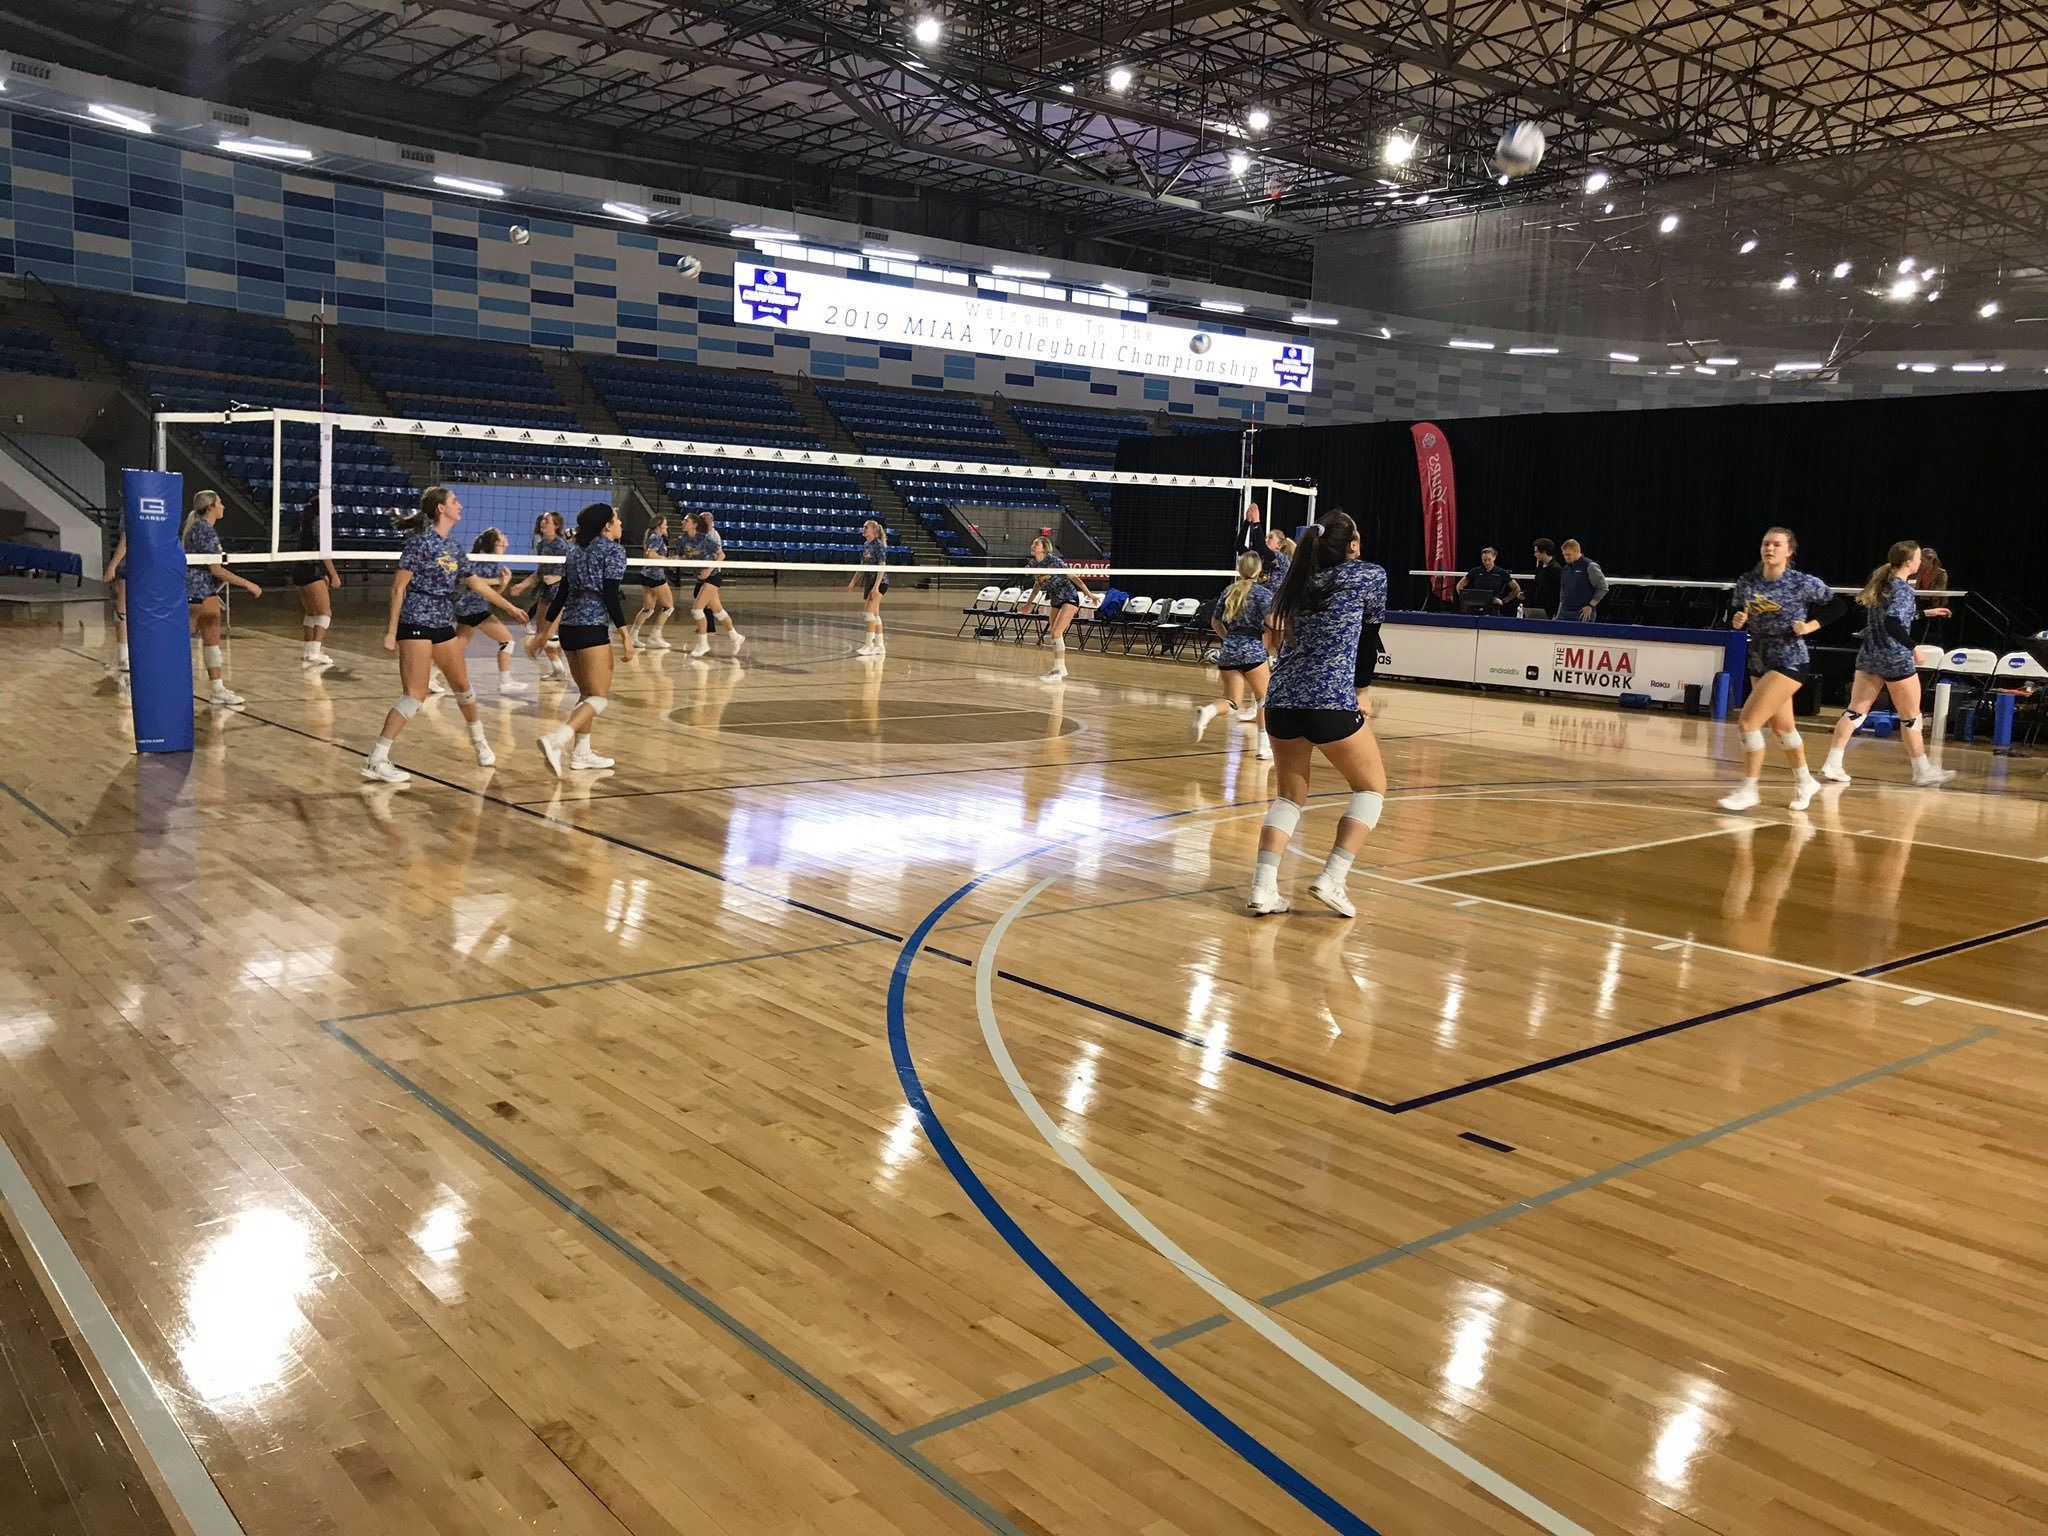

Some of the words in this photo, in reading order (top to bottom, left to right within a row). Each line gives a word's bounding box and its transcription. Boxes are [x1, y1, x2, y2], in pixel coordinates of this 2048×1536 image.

[965, 302, 1063, 329] Welcome
[1085, 319, 1104, 336] To
[1120, 324, 1152, 342] The
[825, 305, 889, 331] 2019
[903, 316, 972, 343] MIAA
[990, 327, 1105, 360] Volleyball
[1117, 345, 1259, 382] Championship
[1555, 647, 1565, 667] THE
[1564, 647, 1632, 673] MIAA
[1553, 669, 1632, 690] NETWORK
